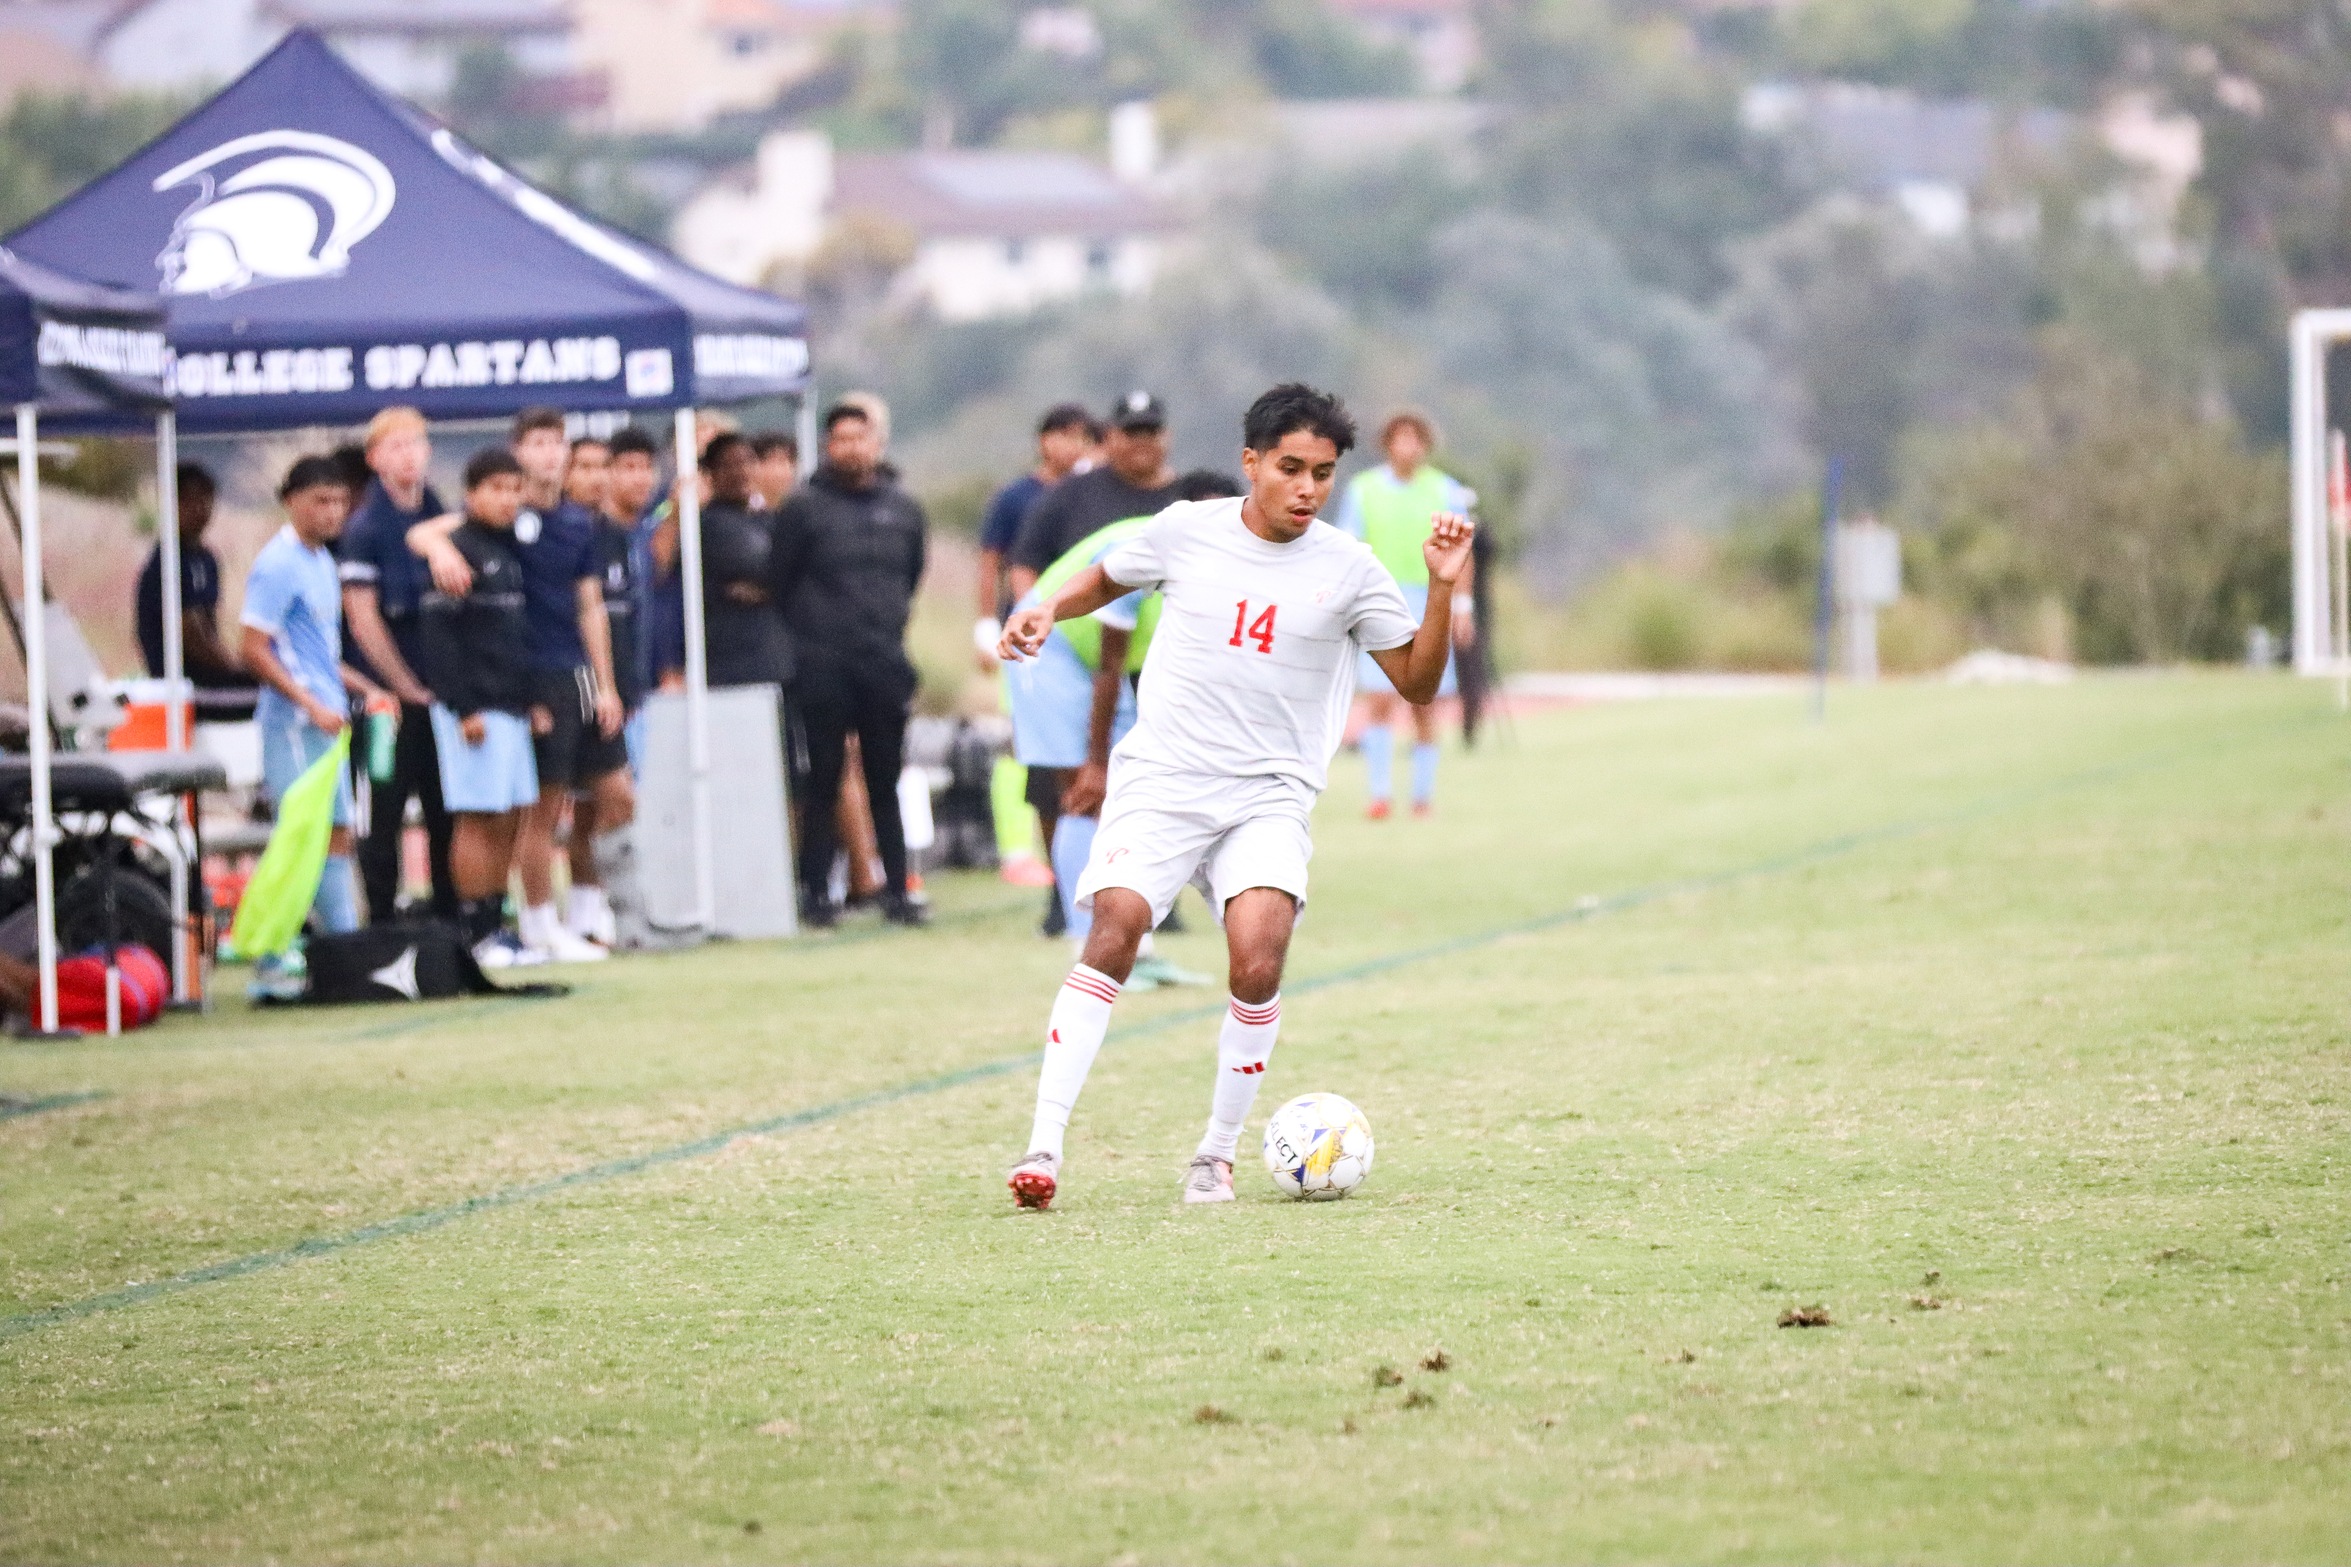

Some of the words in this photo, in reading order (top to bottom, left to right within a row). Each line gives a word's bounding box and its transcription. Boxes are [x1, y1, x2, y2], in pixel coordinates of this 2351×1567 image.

[177, 346, 354, 398] OLLEGE
[364, 335, 622, 390] SPARTANS
[1229, 599, 1278, 655] 14
[1270, 1115, 1299, 1164] ELECT
